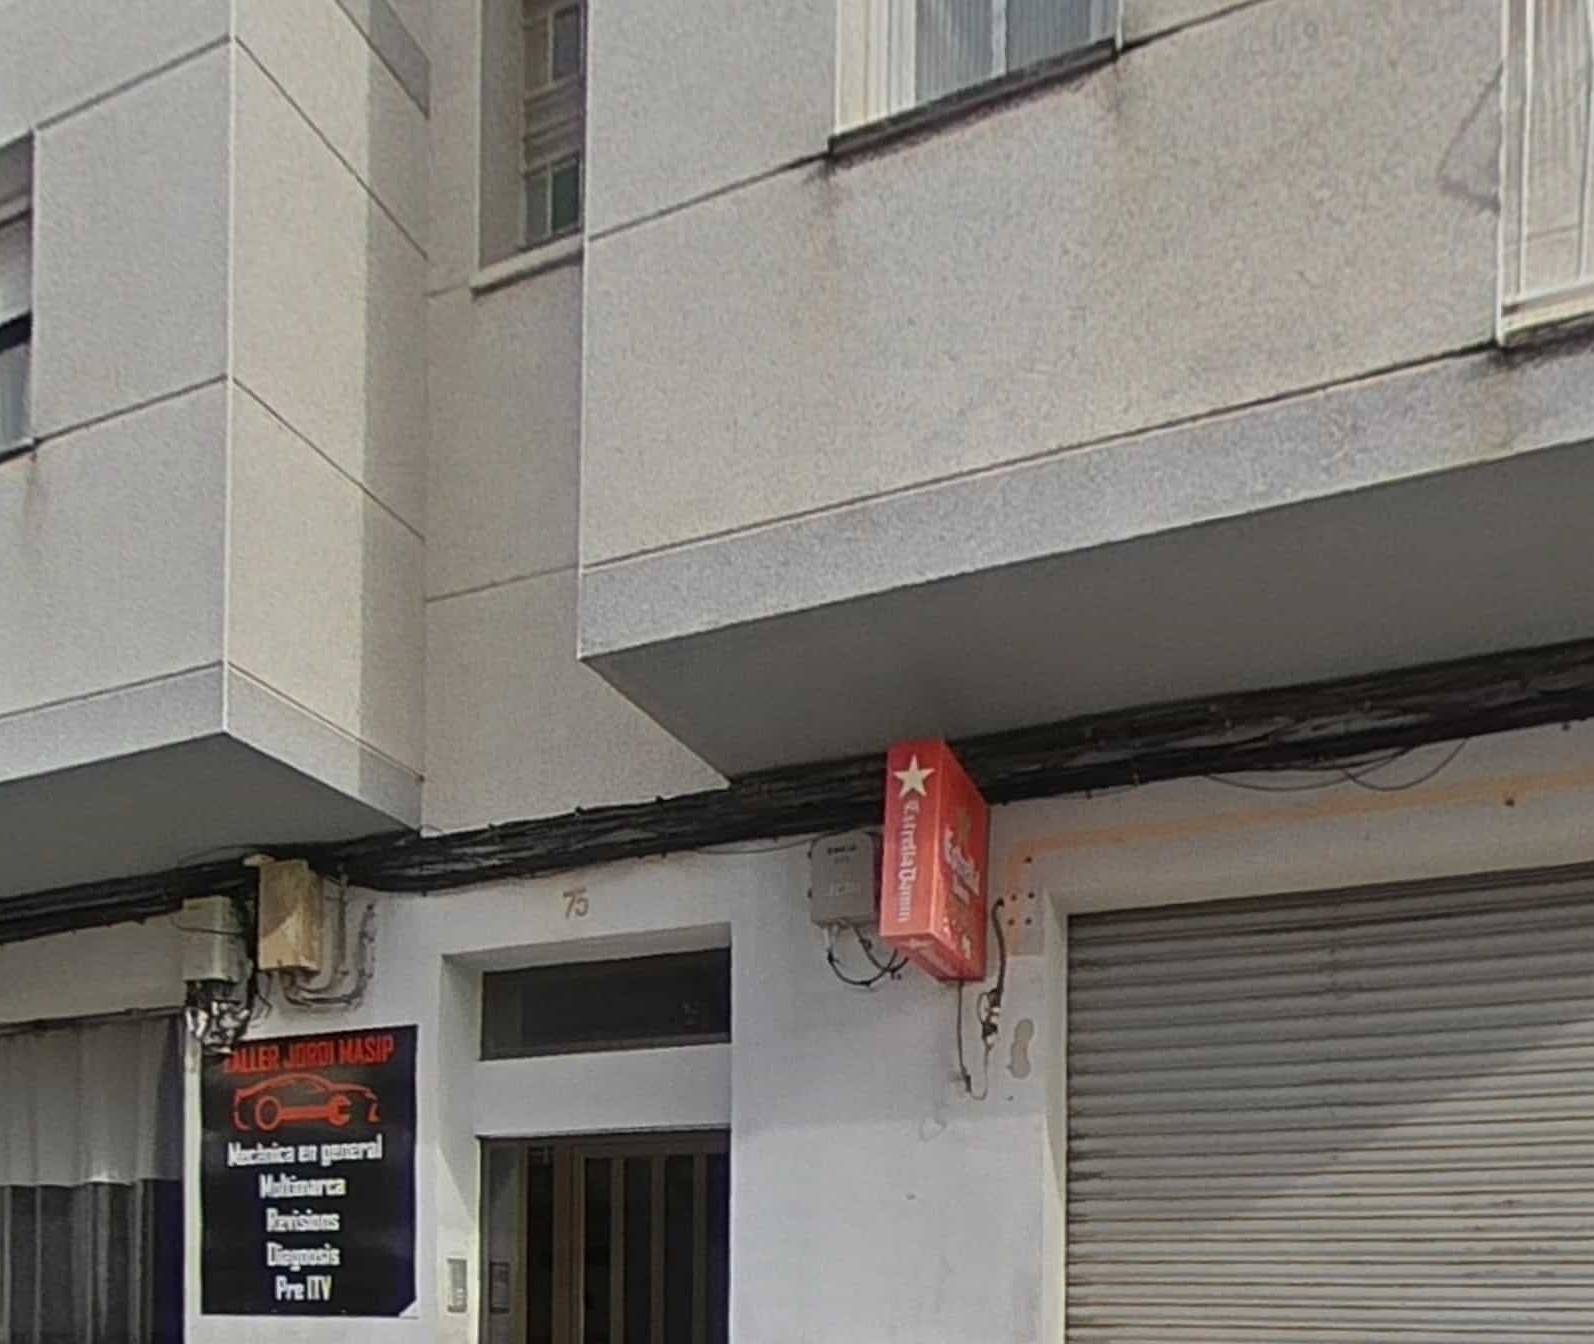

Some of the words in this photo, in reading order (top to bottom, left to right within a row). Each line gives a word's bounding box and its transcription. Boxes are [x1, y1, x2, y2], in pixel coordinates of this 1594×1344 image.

[563, 887, 590, 920] 75
[285, 1040, 335, 1068] JORDI
[338, 1034, 395, 1066] MASIP
[298, 1144, 318, 1163] en
[320, 1133, 383, 1168] general
[259, 1172, 347, 1198] Multimarca
[265, 1207, 341, 1232] Revisions
[265, 1241, 341, 1271] Diagnosis
[274, 1275, 305, 1301] Pre
[306, 1275, 332, 1301] ITV
